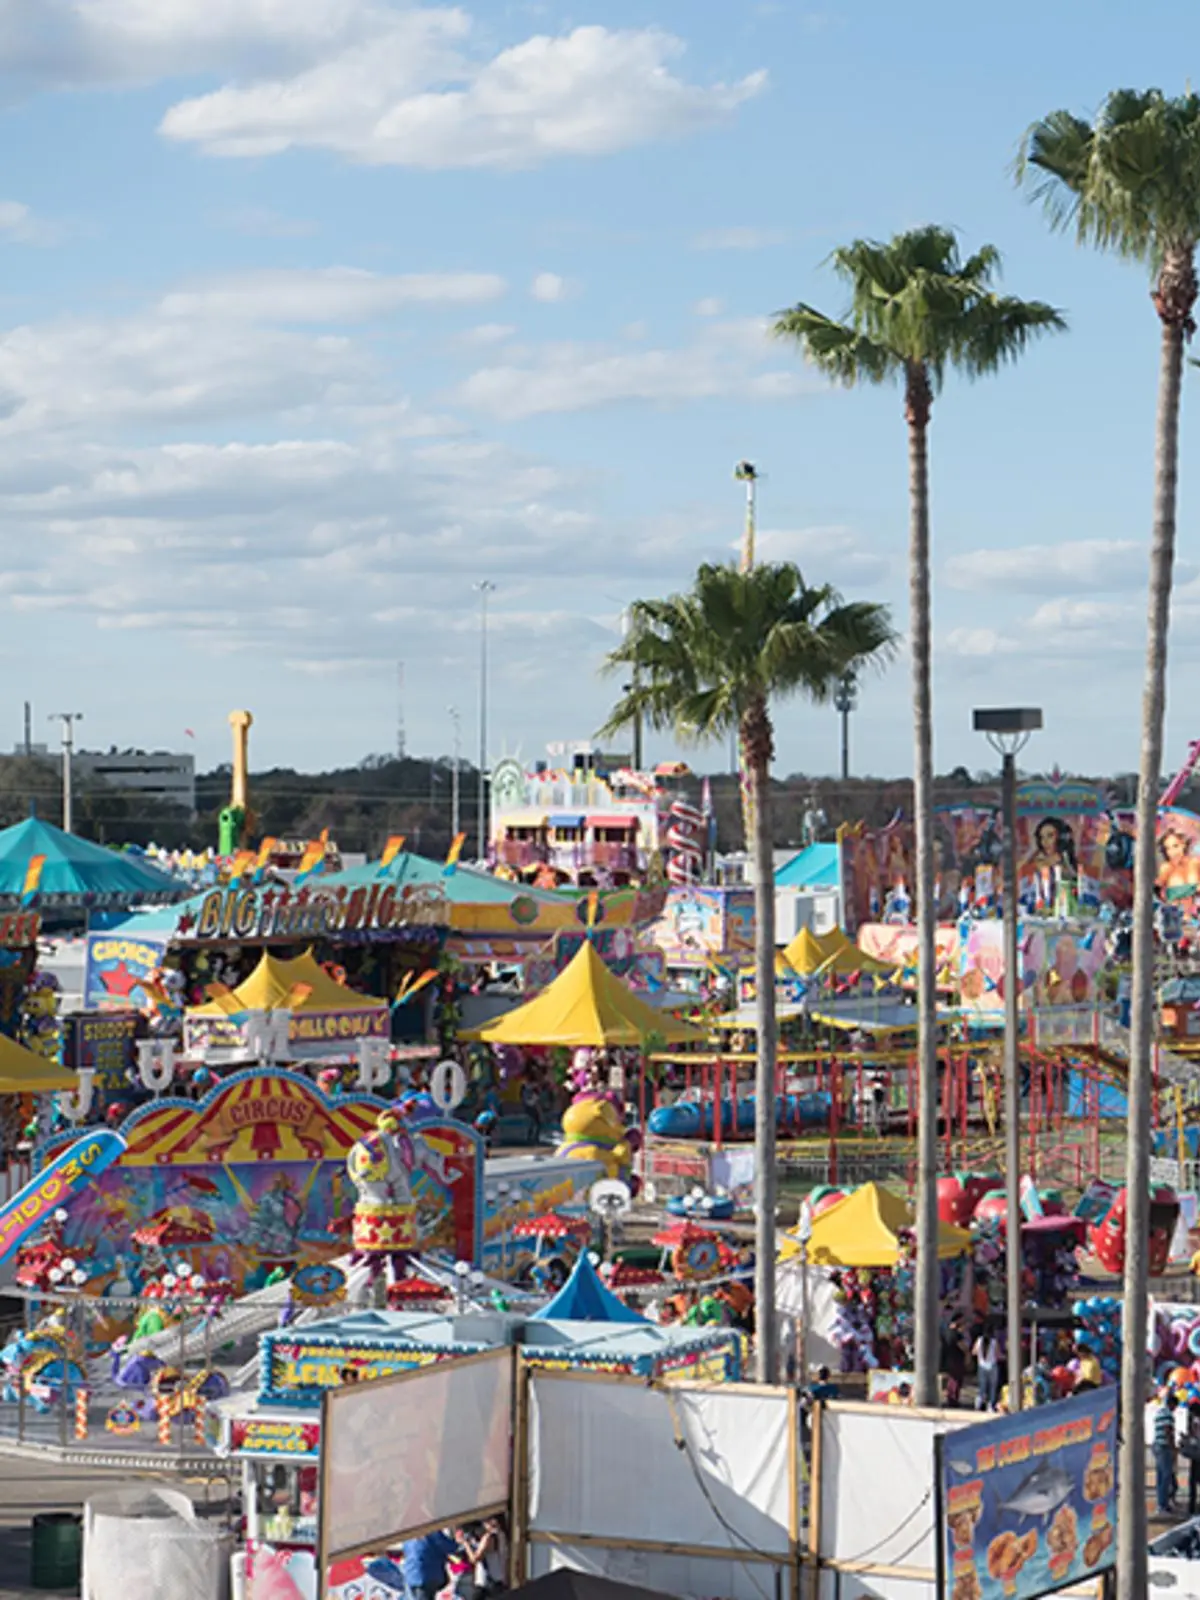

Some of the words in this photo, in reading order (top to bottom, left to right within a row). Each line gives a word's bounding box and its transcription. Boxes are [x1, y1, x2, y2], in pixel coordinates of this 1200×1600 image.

[198, 889, 256, 937] BIG
[92, 941, 159, 967] CHOICE
[84, 1020, 137, 1040] SHOOT
[230, 1097, 307, 1125] CIRCUS
[246, 1423, 304, 1436] CANDY
[242, 1437, 308, 1451] APPLES
